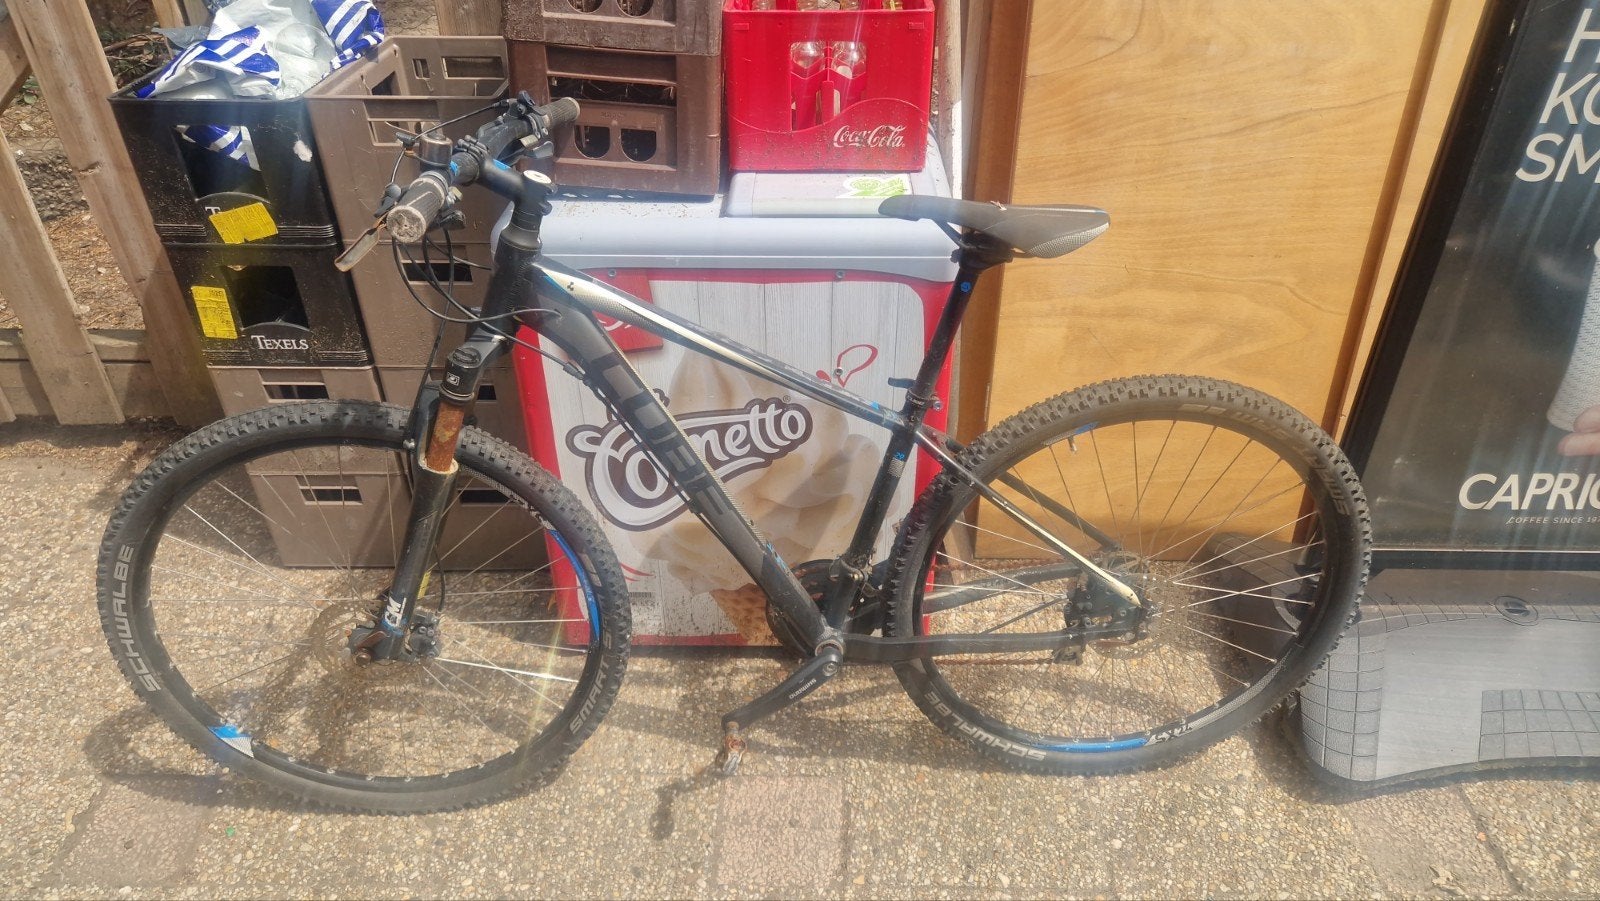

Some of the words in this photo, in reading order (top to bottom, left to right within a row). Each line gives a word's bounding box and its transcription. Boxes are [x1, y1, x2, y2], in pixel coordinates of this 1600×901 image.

[251, 335, 309, 350] TEXELS
[566, 398, 811, 531] Conetto
[1506, 516, 1549, 525] COFFEE
[1552, 516, 1583, 524] SINCE
[112, 544, 161, 691] SCHWALBE
[569, 655, 611, 735] SMART
[924, 691, 1047, 761] SCHWALBE
